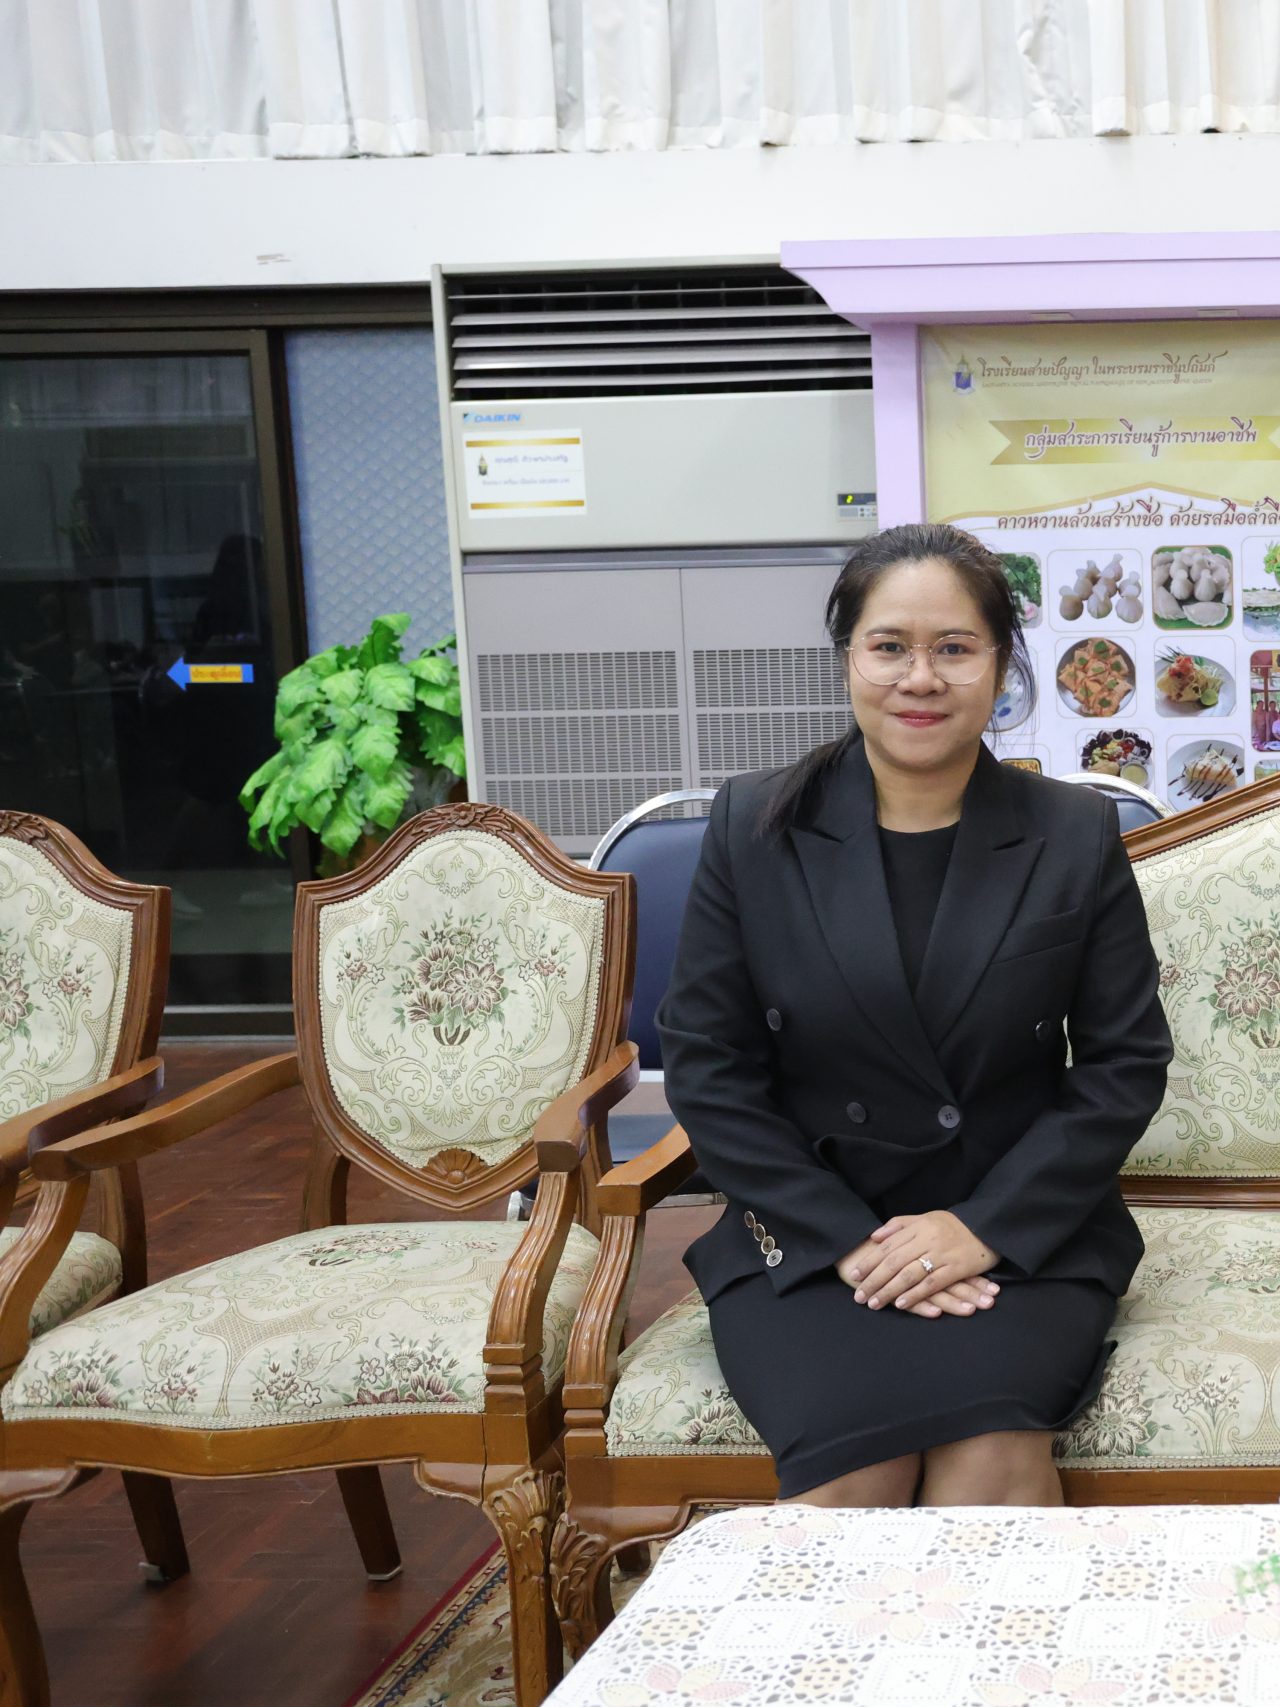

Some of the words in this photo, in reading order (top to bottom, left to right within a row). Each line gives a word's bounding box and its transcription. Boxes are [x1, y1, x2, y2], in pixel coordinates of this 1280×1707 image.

[1024, 416, 1257, 459] กลุ่มสาระการเรียนรู้การงานอาชีพ
[997, 497, 1163, 529] คาวหวานล้วนสร้างชื่อ
